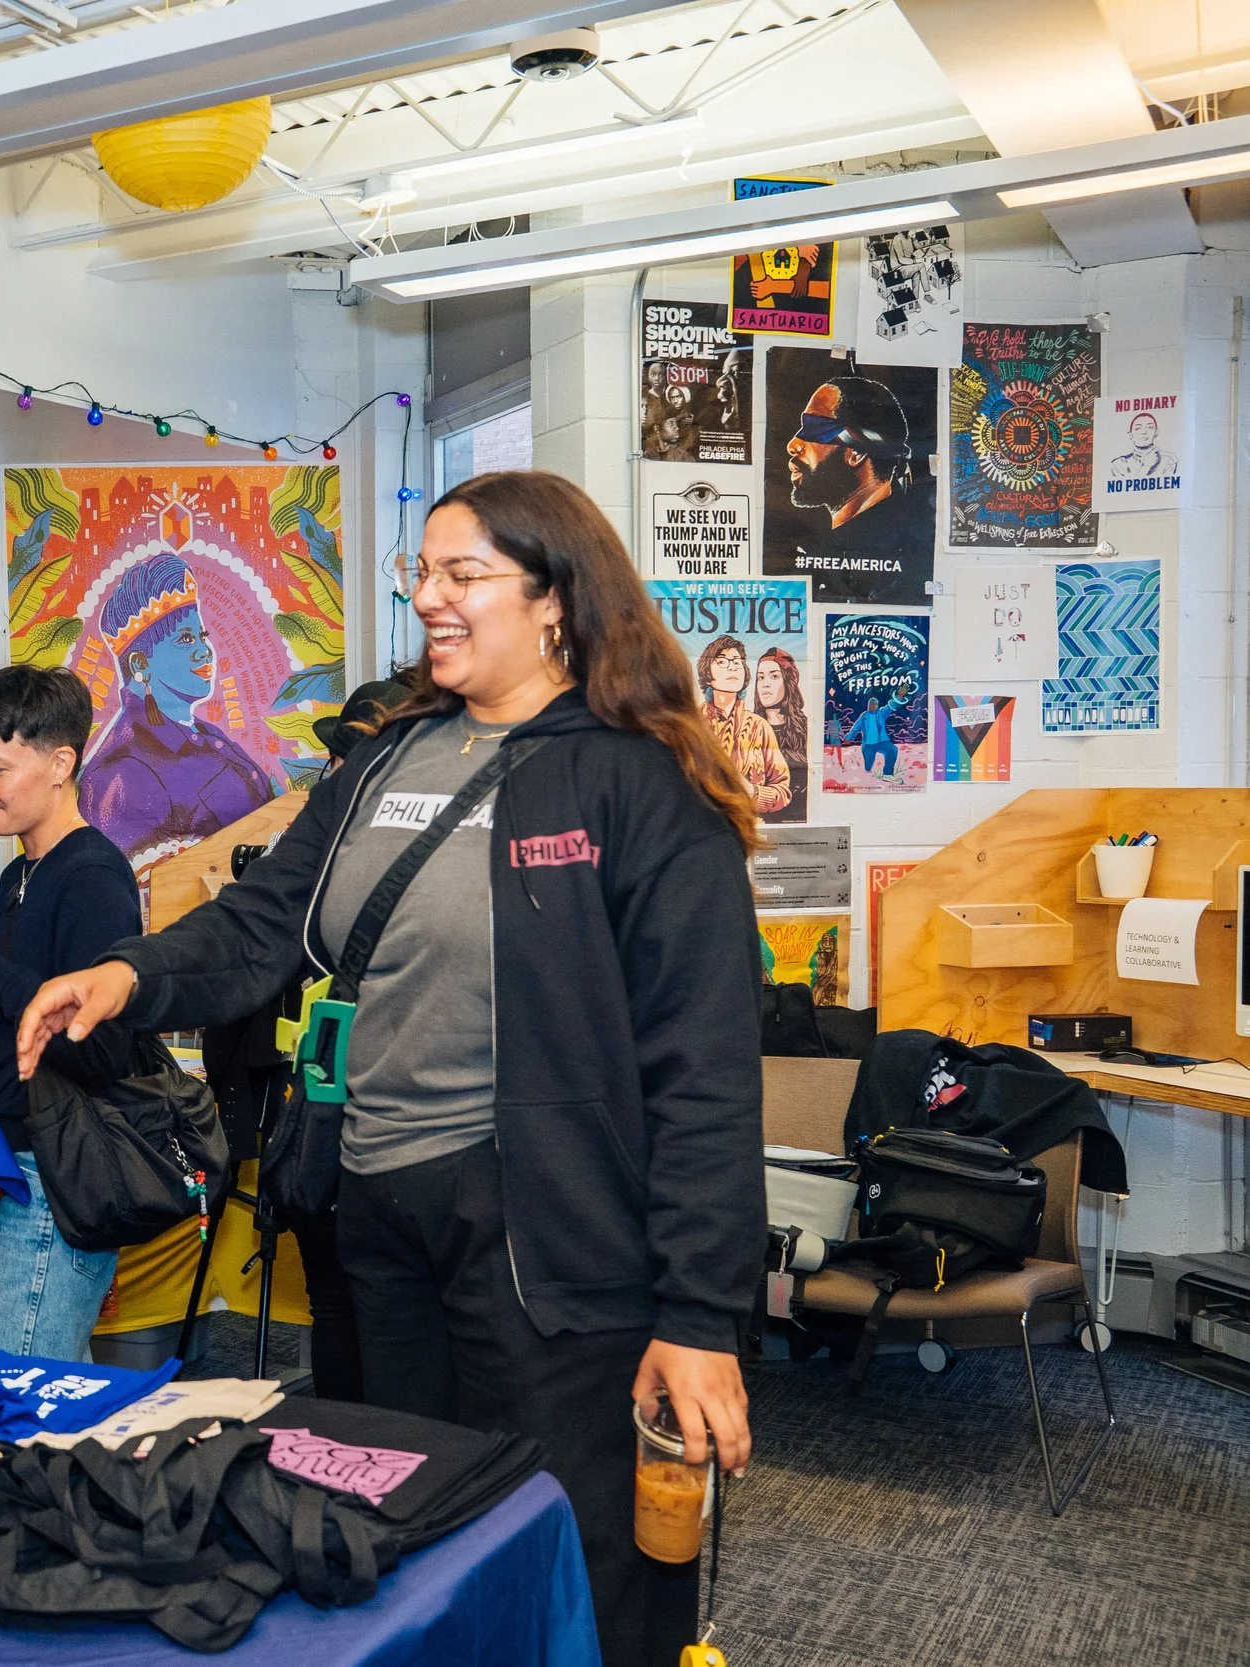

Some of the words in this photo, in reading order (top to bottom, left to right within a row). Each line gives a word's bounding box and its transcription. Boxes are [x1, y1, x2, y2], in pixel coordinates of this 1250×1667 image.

[645, 306, 693, 325] STOP.
[738, 311, 824, 330] SANTUARIO
[645, 324, 737, 345] SHOOTING.
[977, 329, 999, 347] We
[1002, 328, 1027, 345] hold
[1029, 330, 1066, 349] these
[645, 341, 719, 360] PEOPLE.
[988, 345, 1027, 360] truths
[1028, 350, 1042, 359] to
[1045, 350, 1064, 361] be
[669, 366, 704, 383] STOP
[1052, 351, 1096, 386] CULTURE
[1058, 373, 1096, 396] human
[1066, 385, 1093, 414] right
[1115, 400, 1131, 412] NO
[1133, 396, 1177, 411] BINARY
[699, 445, 745, 453] PHILADELPHIA
[699, 452, 745, 461] CEASEFIRE
[1107, 480, 1123, 493] NO
[1125, 476, 1181, 492] PROBLEM
[996, 490, 1052, 502] CULTURAL
[666, 509, 686, 524] WE
[688, 509, 709, 524] SEE
[712, 510, 736, 524] YOU
[976, 507, 1023, 525] SOCIAL
[1025, 511, 1061, 528] GOOD
[655, 526, 698, 541] TRUMP
[701, 527, 726, 541] AND
[729, 527, 748, 542] WE
[974, 522, 1015, 541] WELLSPRING
[1024, 529, 1039, 542] free
[1039, 523, 1078, 540] EXPRESSION
[664, 543, 702, 558] KNOW
[704, 544, 740, 558] WHAT
[677, 560, 701, 575] YOU
[704, 560, 727, 575] ARE
[795, 556, 902, 572] #FREEAMERICA
[201, 583, 234, 609] BISCUIT
[685, 584, 704, 594] WE
[708, 584, 735, 594] WHO
[738, 584, 766, 594] SEEK
[984, 583, 1031, 600] JUST
[194, 566, 230, 590] TASTING
[230, 589, 247, 607] LIKE
[251, 614, 264, 629] HOT
[261, 628, 285, 676] BUTTERED
[993, 606, 1022, 627] DO
[233, 609, 261, 647] DRIPPING
[830, 638, 859, 650] WORN
[862, 639, 878, 653] MY
[832, 625, 849, 639] MY
[850, 622, 901, 641] ANCESTORS
[900, 635, 919, 653] HAVE
[257, 650, 268, 660] IN
[830, 651, 845, 660] AND
[833, 651, 869, 672] FOUGHT
[231, 626, 255, 663] FREEDOM
[251, 665, 268, 705] LOOKING
[838, 669, 853, 682] FOR
[854, 663, 873, 672] THIS
[262, 661, 277, 689] MAPLE
[848, 675, 913, 693] FREEDOM
[211, 619, 228, 638] LIKE
[225, 637, 244, 669] LIVING
[253, 726, 262, 751] WANT
[220, 676, 245, 732] PLACE
[754, 855, 779, 865] Gender
[765, 925, 797, 944] SOAR
[799, 926, 819, 940] IN
[1126, 932, 1172, 944] TECHNOLOGY
[1174, 936, 1180, 944] &
[1125, 944, 1160, 955] LEARNING
[1125, 956, 1182, 969] COLLABORATIVE
